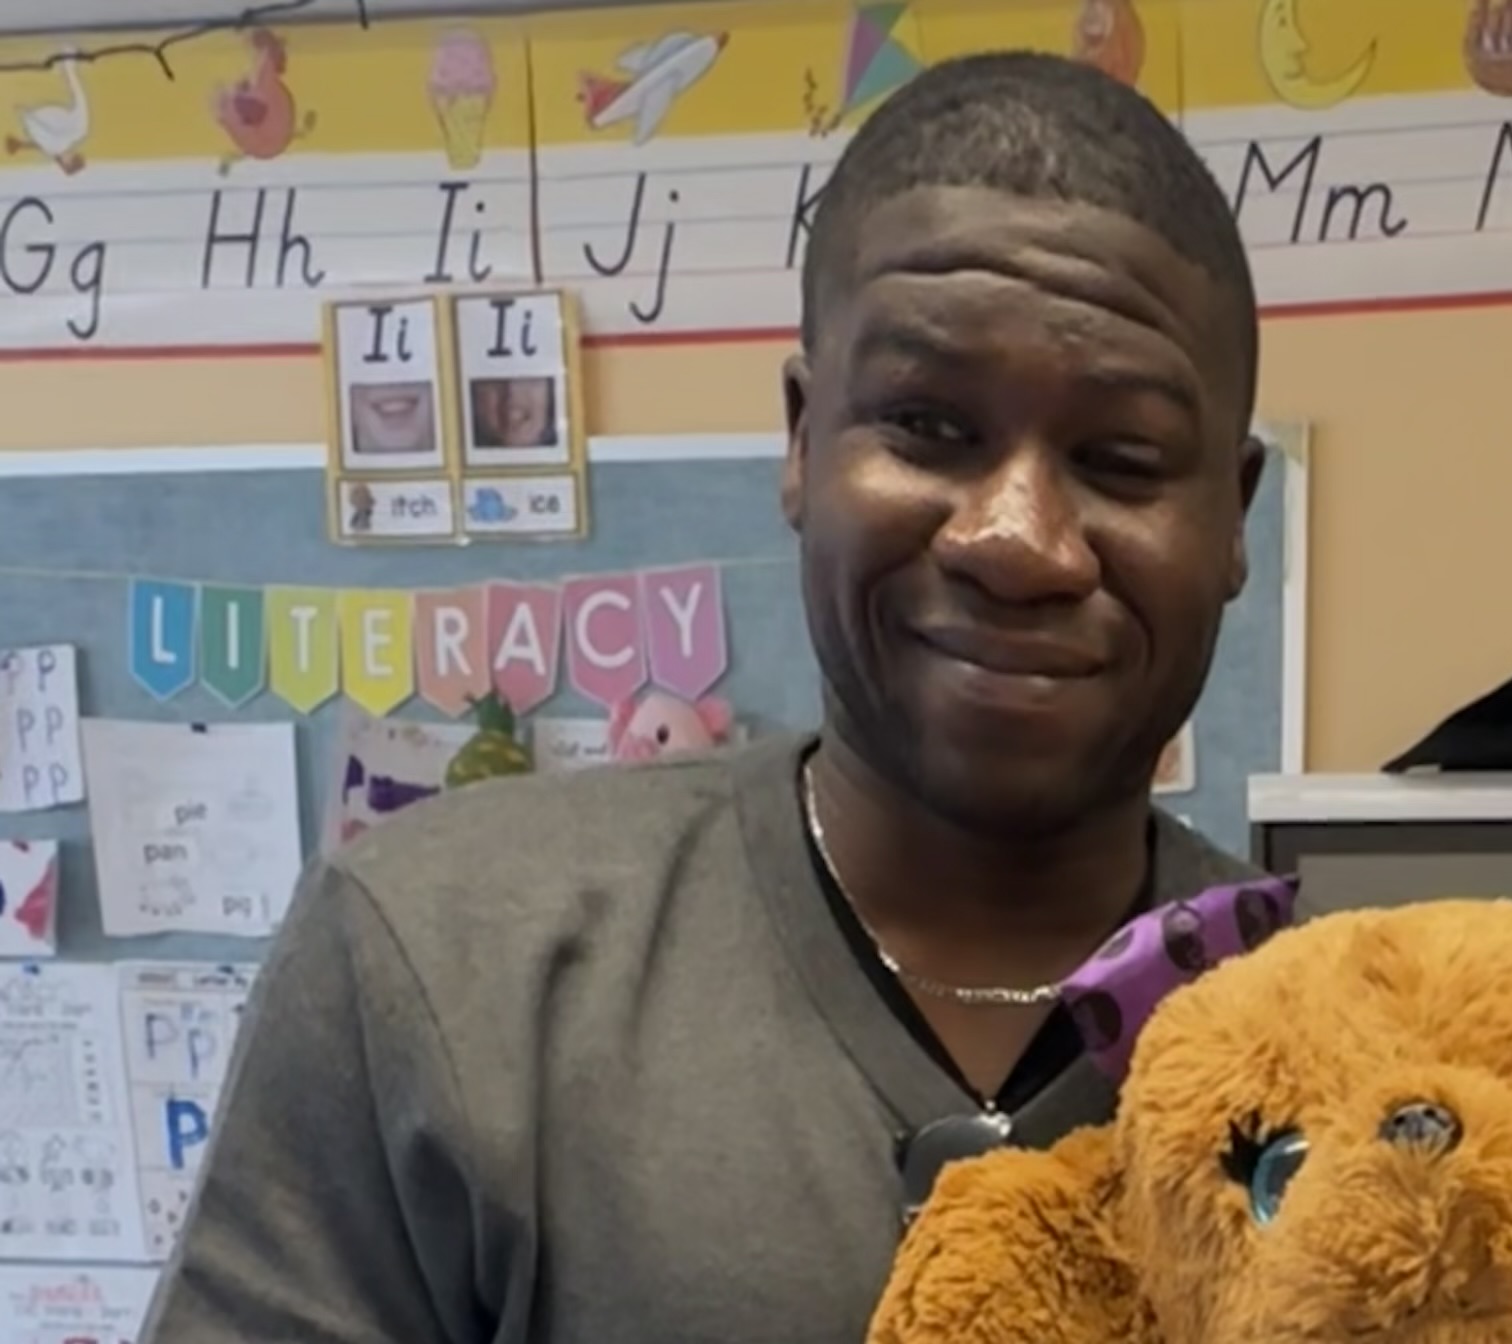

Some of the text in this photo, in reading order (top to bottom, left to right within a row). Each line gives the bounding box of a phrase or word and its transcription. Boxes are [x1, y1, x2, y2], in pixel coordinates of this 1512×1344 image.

[0, 197, 106, 340] Gg
[202, 187, 326, 290] Hh
[423, 182, 492, 284] Ii
[583, 172, 680, 324] Jj
[1233, 135, 1407, 244] Mm
[362, 304, 412, 363] Ii
[486, 298, 537, 358] Ii
[391, 495, 438, 518] itch
[529, 494, 561, 513] ice
[152, 582, 703, 678] LITERACY
[143, 843, 188, 863] pan
